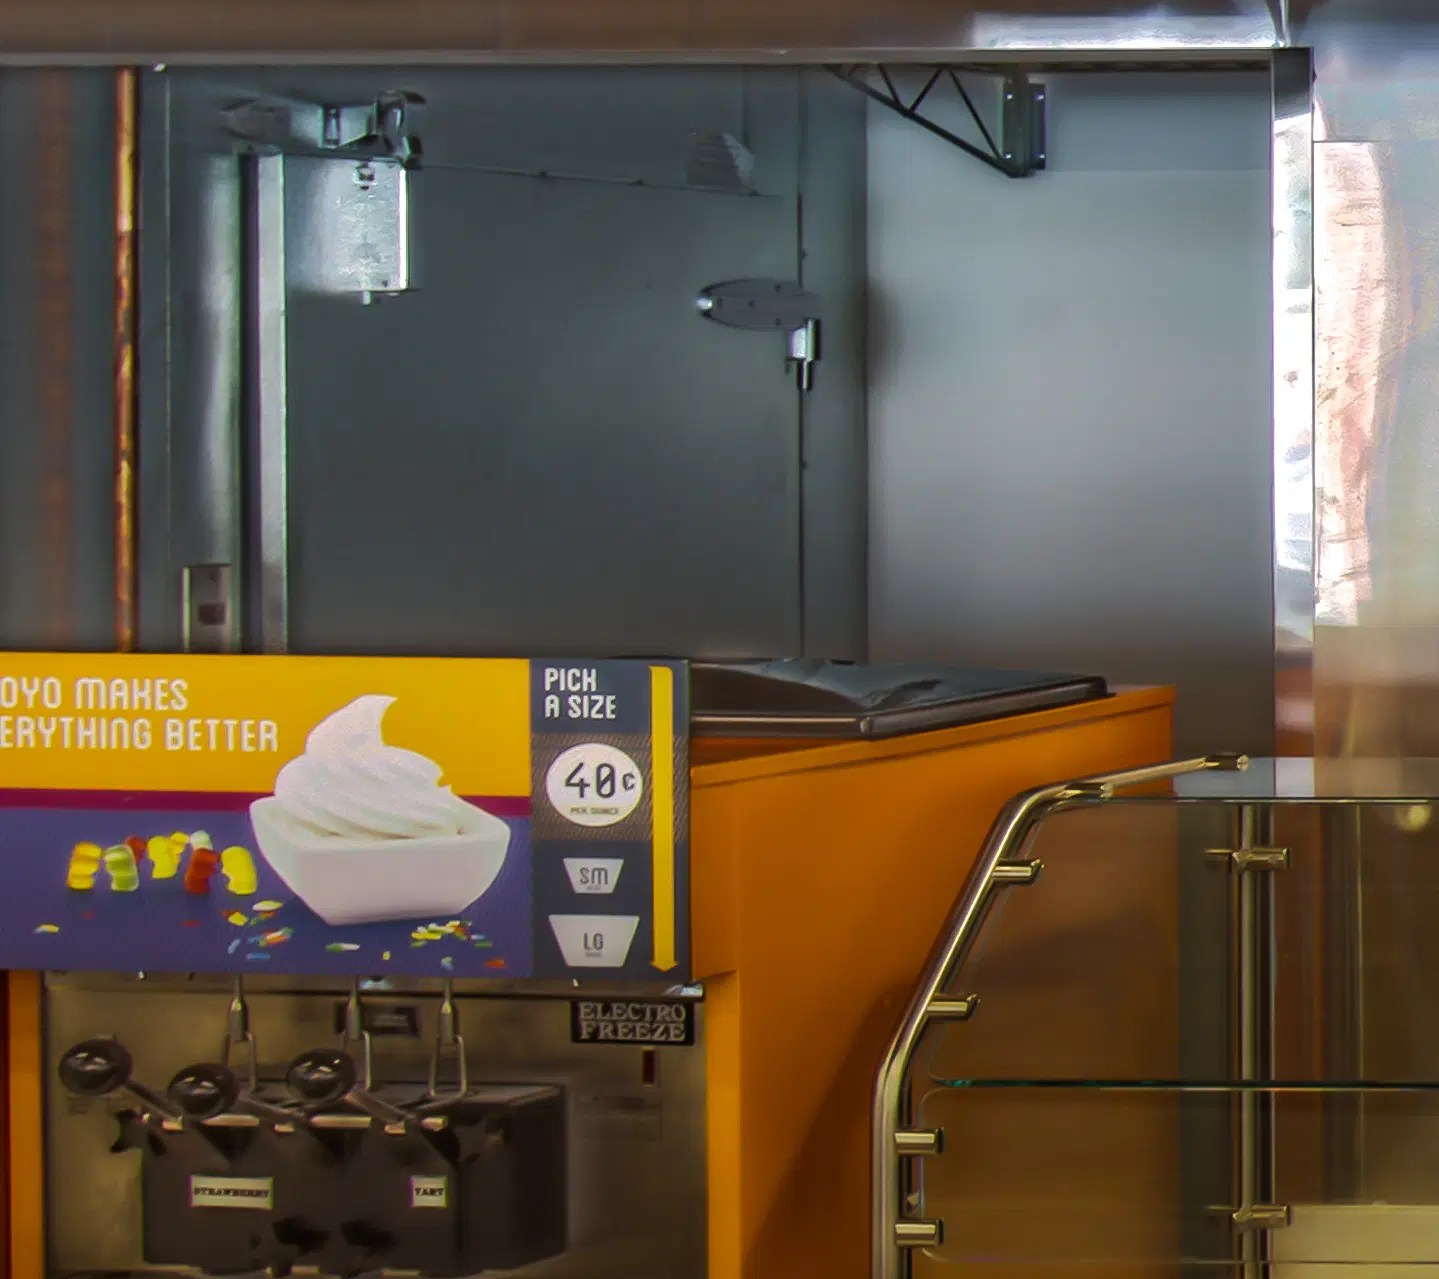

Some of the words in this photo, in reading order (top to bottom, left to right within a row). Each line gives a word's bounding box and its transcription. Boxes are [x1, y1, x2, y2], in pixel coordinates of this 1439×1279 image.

[544, 668, 597, 691] PICK
[75, 677, 189, 711] MAKES
[545, 695, 560, 718] A
[567, 695, 616, 719] SIZE
[165, 718, 278, 752] BETTER
[579, 867, 609, 885] SM
[583, 933, 604, 950] LG
[579, 1002, 686, 1021] ELECTRO
[580, 1022, 686, 1041] FREEZE
